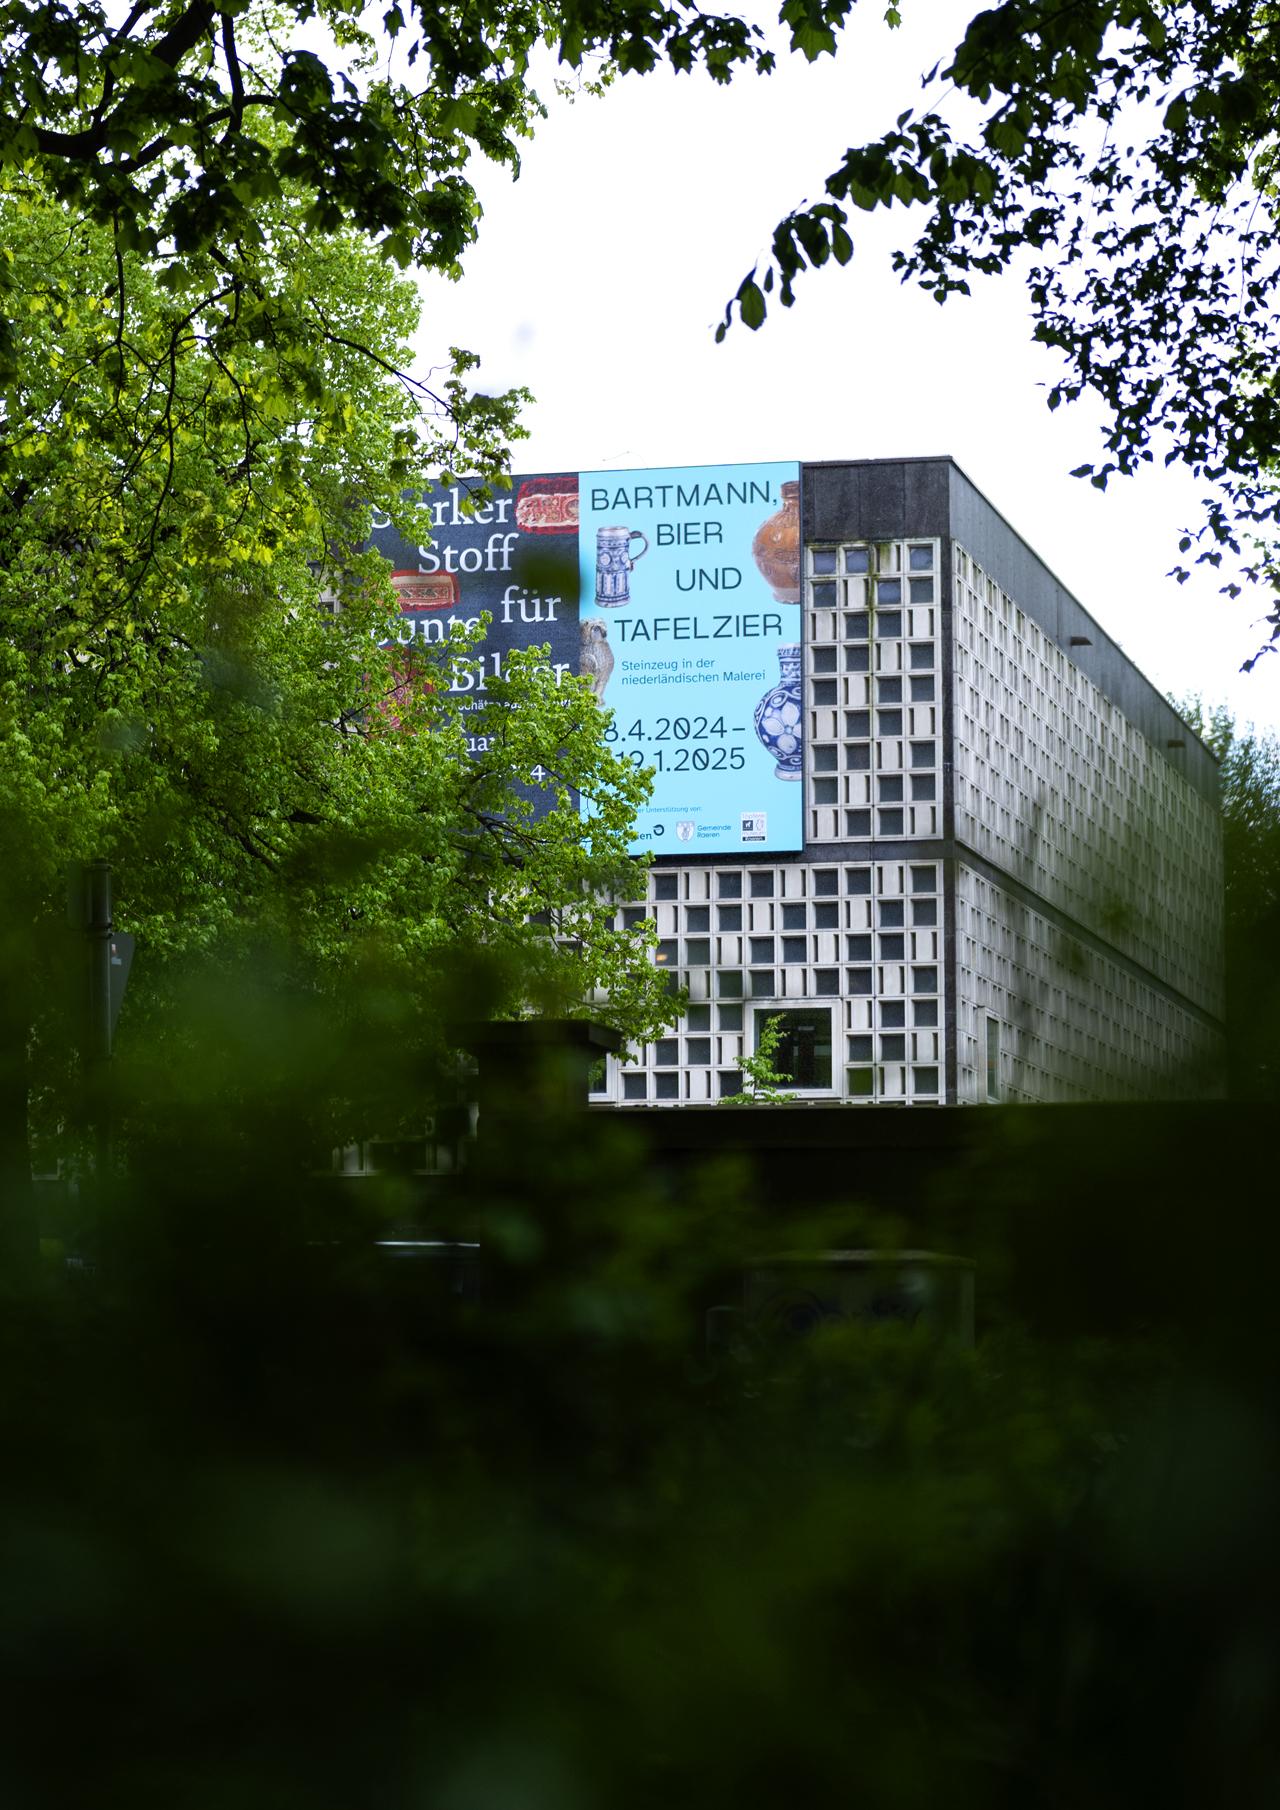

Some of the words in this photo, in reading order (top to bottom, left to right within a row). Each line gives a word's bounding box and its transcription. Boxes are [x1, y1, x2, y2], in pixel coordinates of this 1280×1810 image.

[371, 487, 512, 529] Srker
[591, 480, 777, 511] BARTMANN,
[656, 521, 723, 546] BIER
[418, 532, 520, 574] Stoff
[676, 567, 742, 591] UND
[500, 585, 561, 623] für
[371, 614, 483, 646] unte
[614, 613, 782, 642] TAFELZIER
[449, 652, 570, 692] Bilr
[621, 660, 678, 672] Steinzeug
[682, 658, 692, 669] in
[695, 658, 715, 669] der
[621, 672, 720, 685] niederländischen
[723, 669, 766, 681] Malerei
[602, 716, 746, 742] 8.4.2024–
[615, 746, 745, 772] 191.2025
[697, 824, 732, 832] Gemeinde
